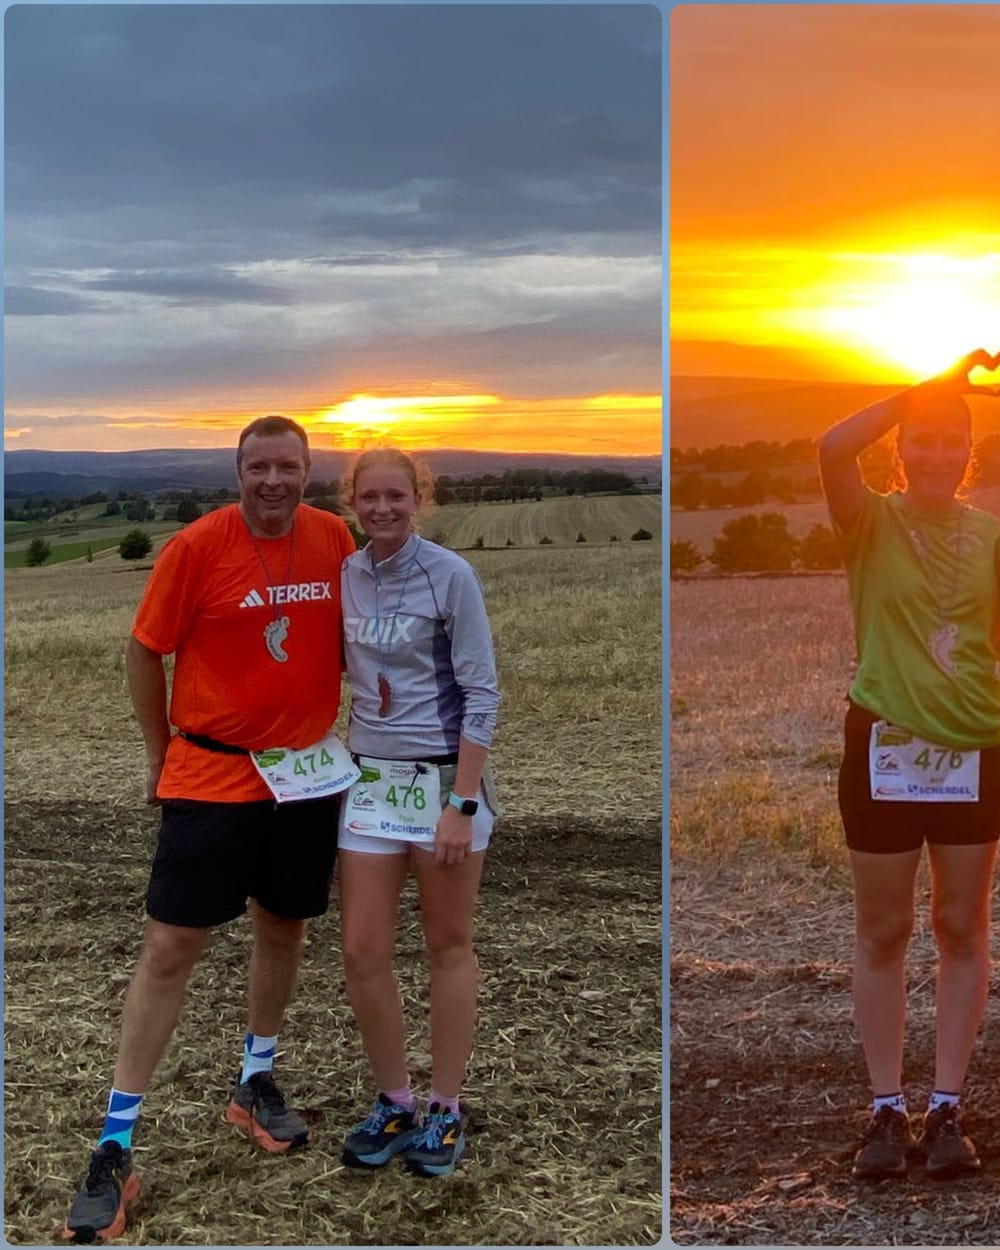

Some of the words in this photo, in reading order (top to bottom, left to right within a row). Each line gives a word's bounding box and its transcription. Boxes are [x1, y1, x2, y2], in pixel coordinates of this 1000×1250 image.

[266, 582, 332, 605] TERREX
[346, 616, 417, 645] SWIX
[293, 747, 335, 777] 474
[914, 747, 963, 771] 476
[312, 771, 354, 793] SCHERDEL
[920, 786, 972, 795] SCHERDEL
[385, 785, 427, 811] 478
